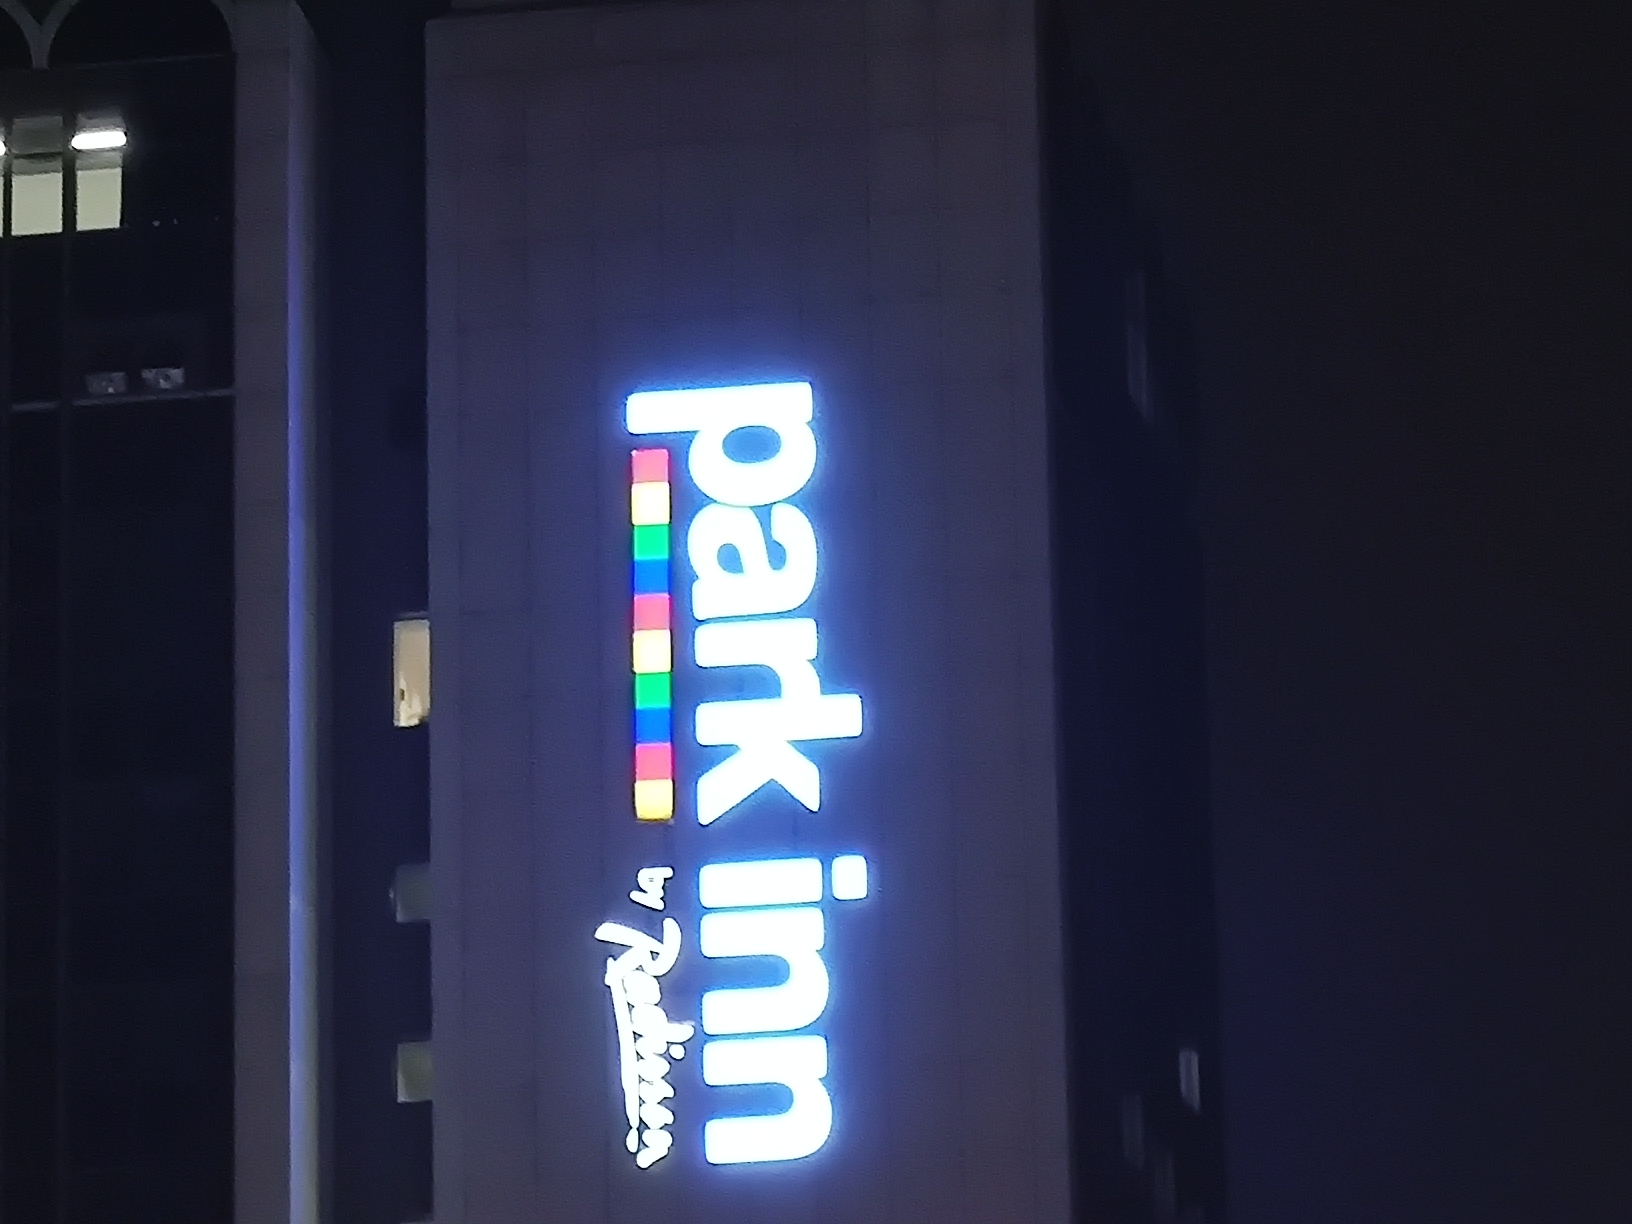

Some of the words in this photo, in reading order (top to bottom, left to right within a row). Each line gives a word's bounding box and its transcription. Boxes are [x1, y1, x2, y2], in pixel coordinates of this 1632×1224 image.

[625, 381, 864, 827] park
[629, 866, 674, 911] by
[697, 855, 869, 1166] inn
[593, 917, 695, 1170] Radisson
